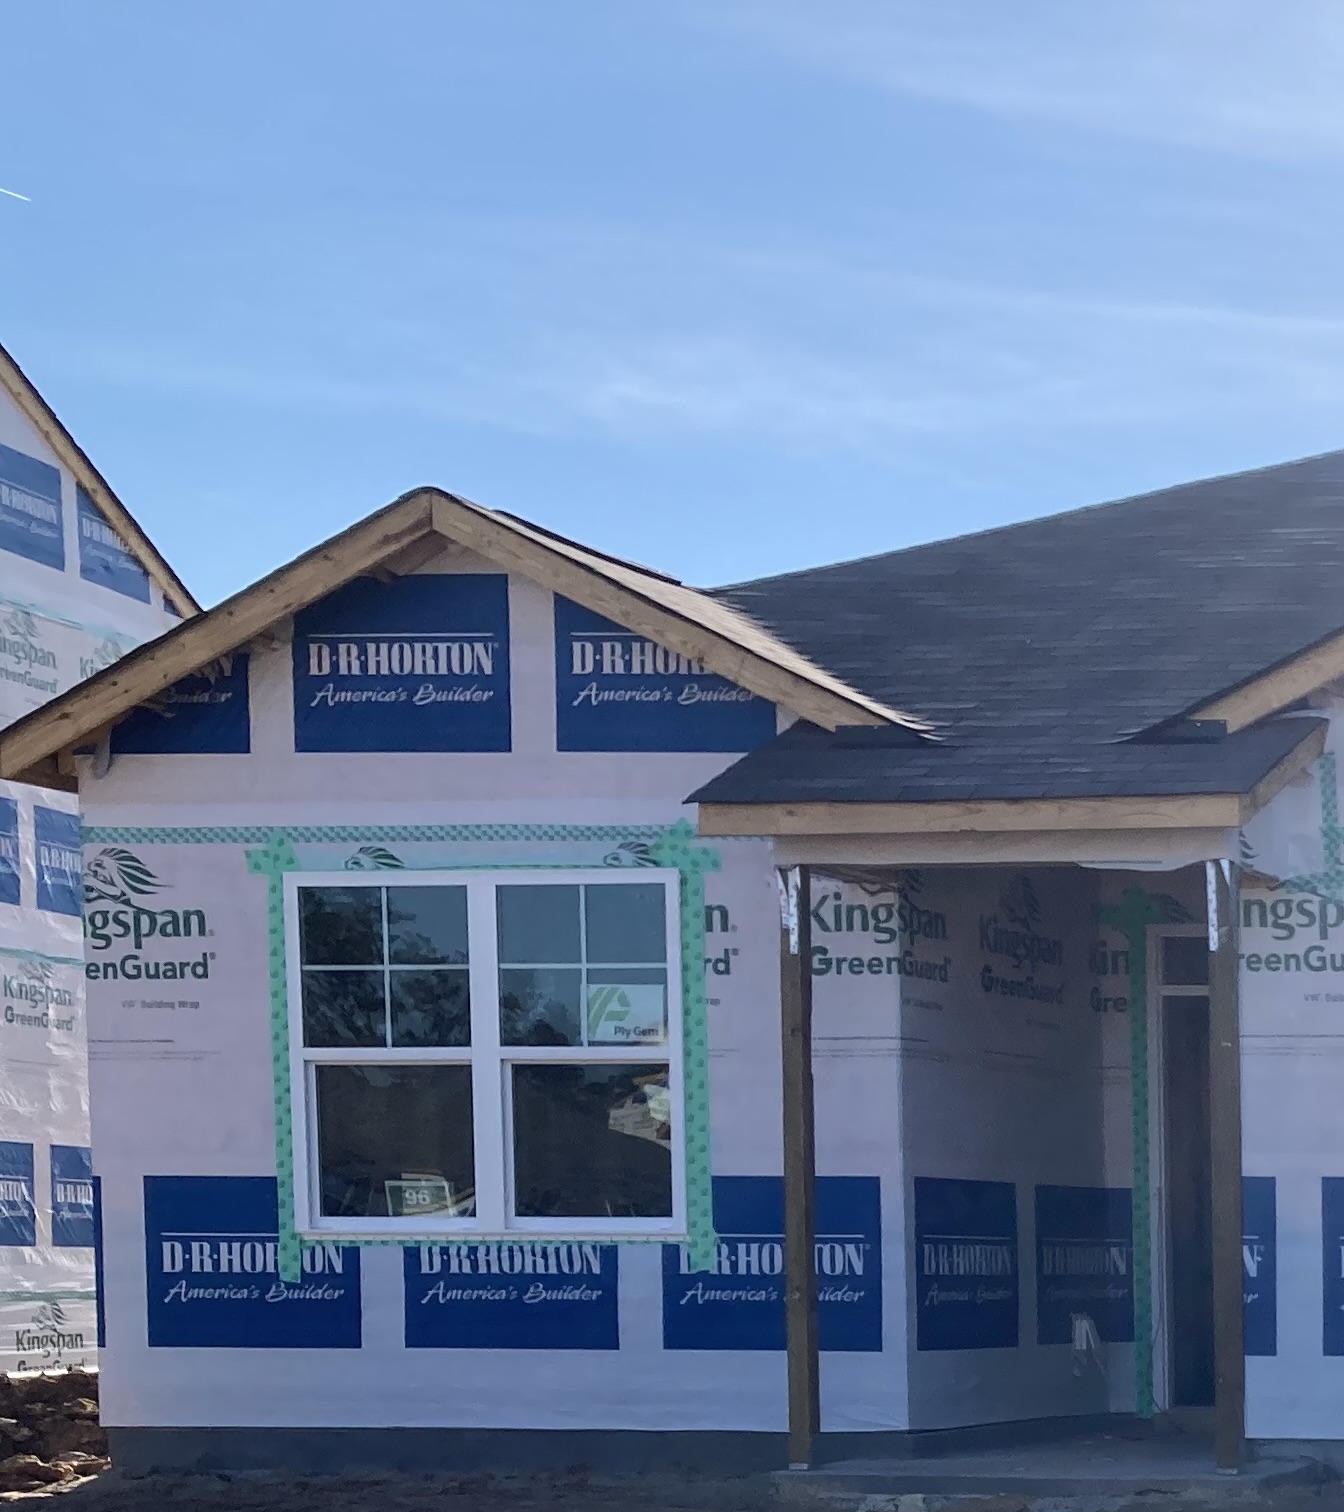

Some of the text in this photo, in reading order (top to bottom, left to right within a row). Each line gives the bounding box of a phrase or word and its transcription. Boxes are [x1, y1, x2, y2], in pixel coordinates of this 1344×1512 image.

[309, 683, 494, 707] America's Builder
[572, 682, 673, 706] America's
[83, 908, 207, 951] gspan
[85, 952, 210, 980] enGuard
[404, 1188, 431, 1206] 96
[164, 1279, 345, 1304] America's Builder
[420, 1280, 603, 1304] America's Builder
[679, 1281, 779, 1305] America's
